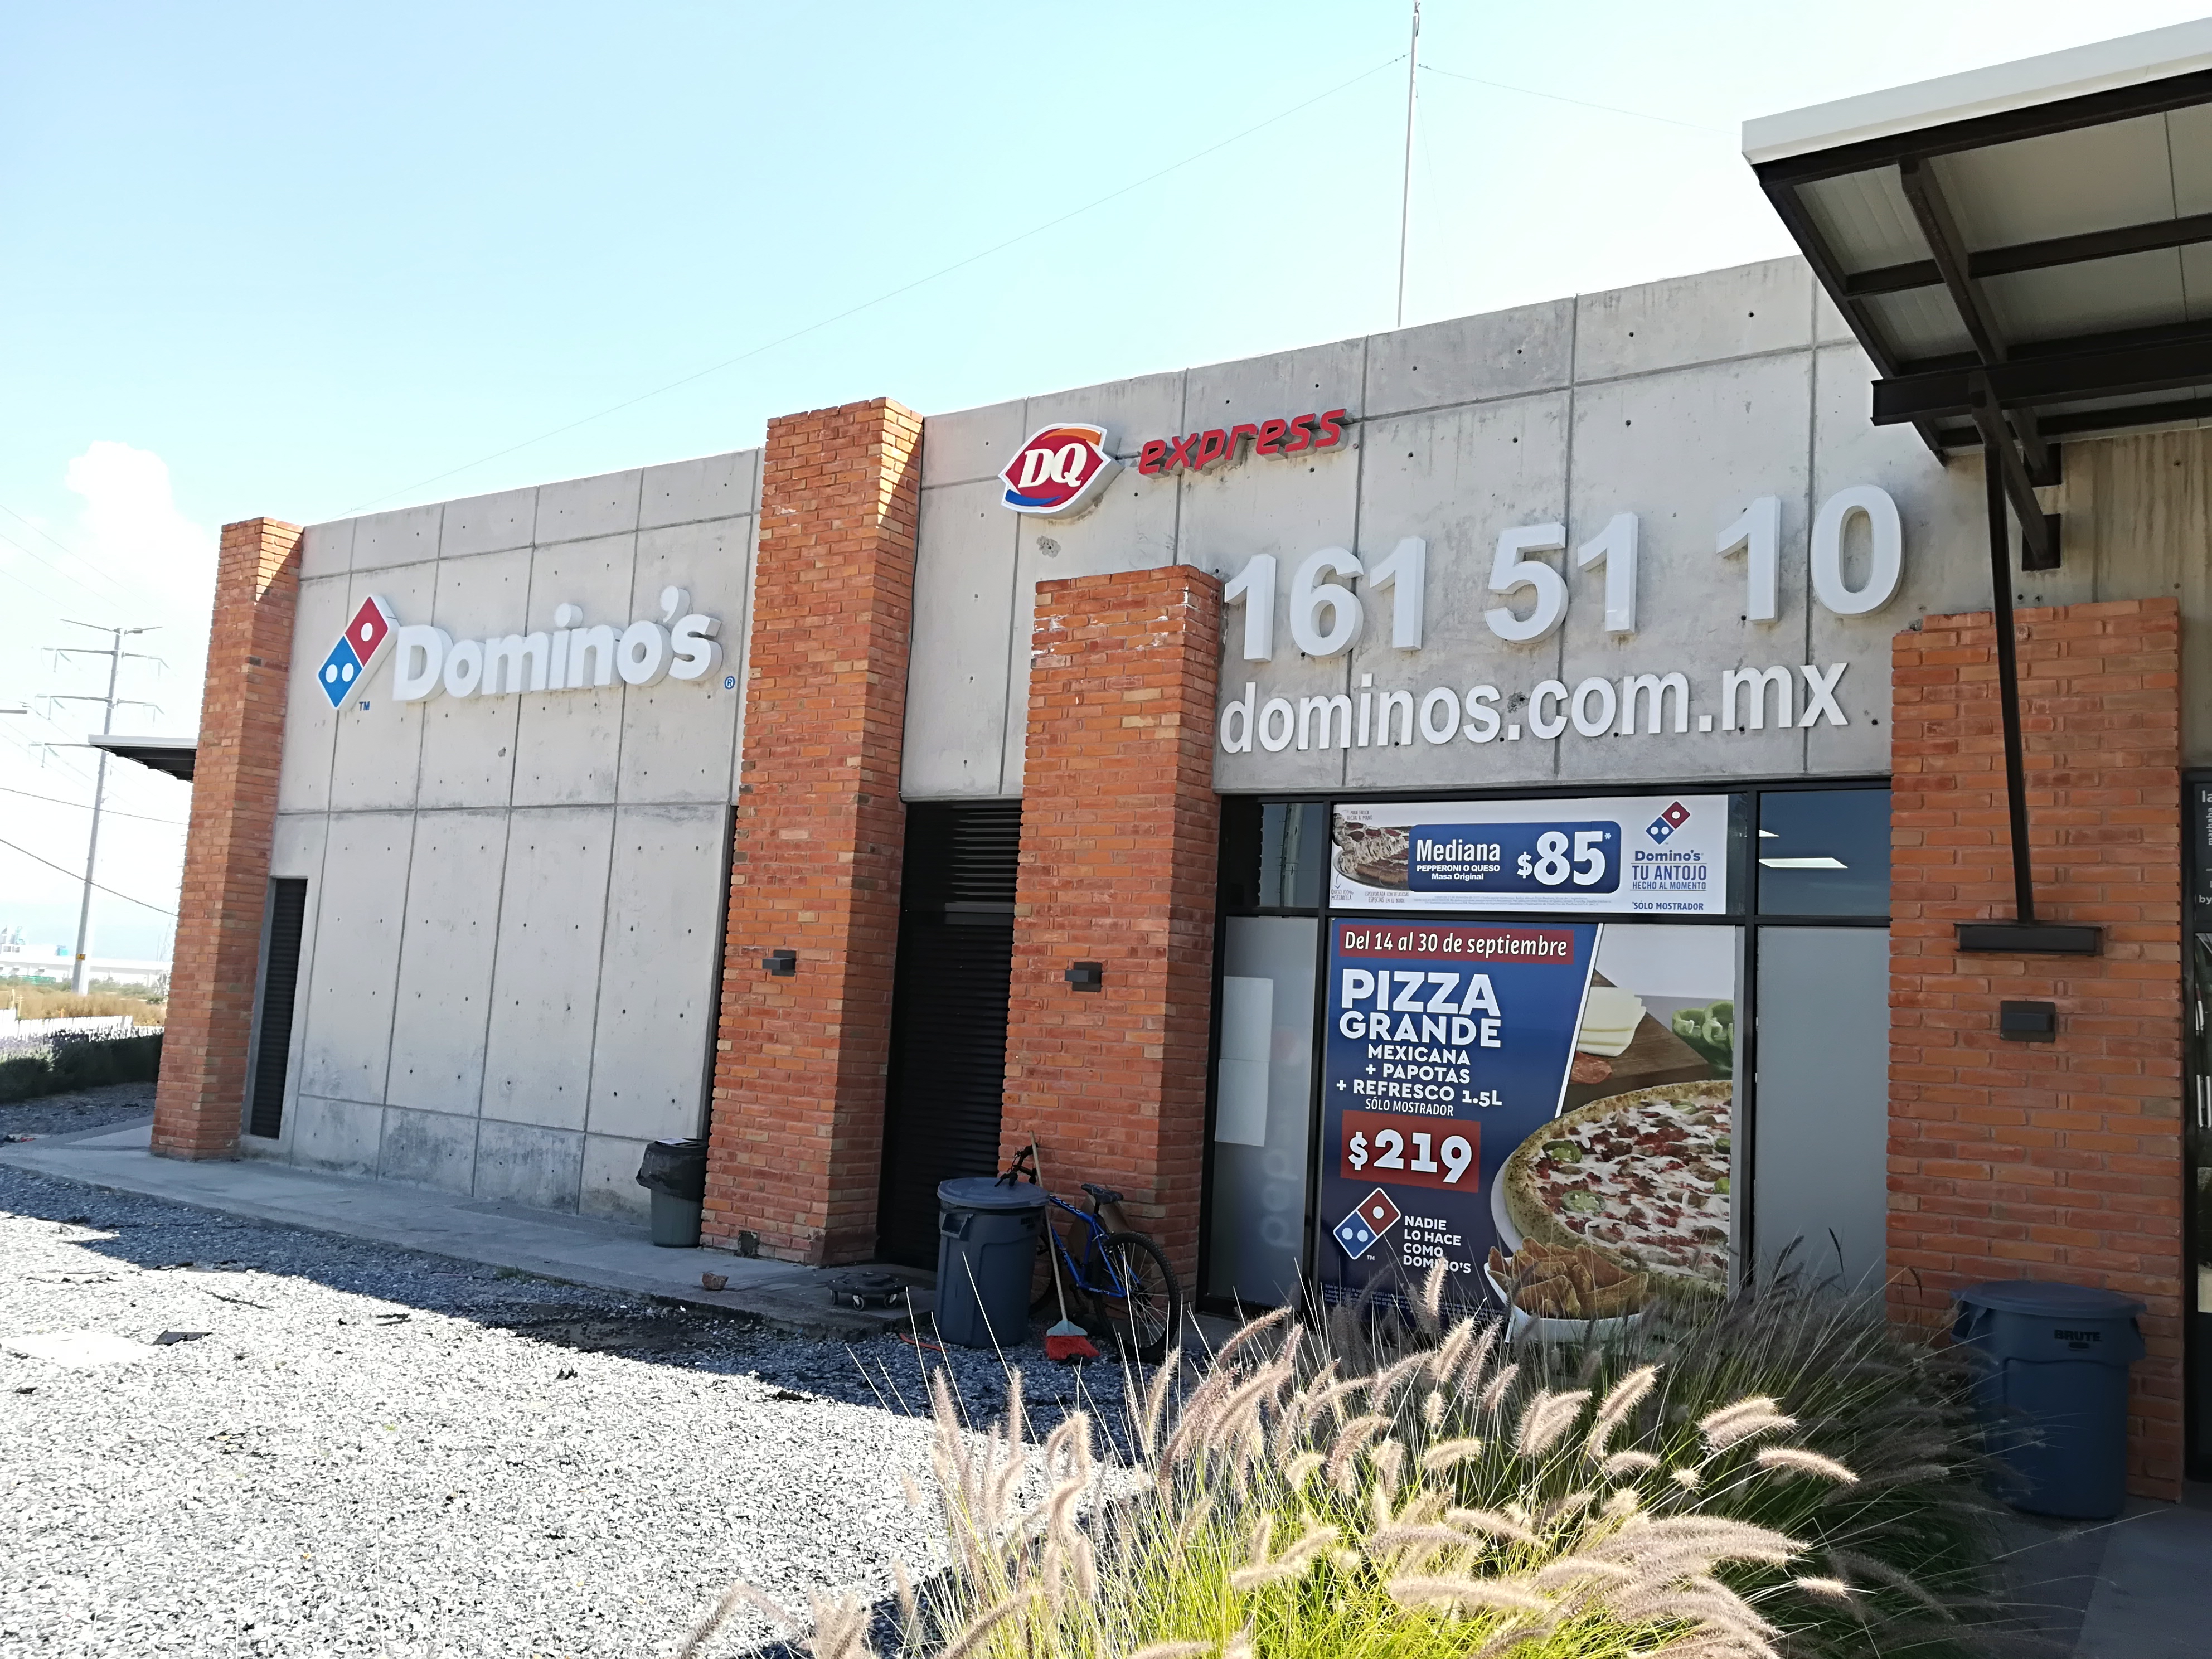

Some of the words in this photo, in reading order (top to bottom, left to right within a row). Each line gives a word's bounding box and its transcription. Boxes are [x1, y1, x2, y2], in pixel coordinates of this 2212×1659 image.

[1139, 408, 1351, 479] express
[1018, 443, 1087, 488] DQ
[1225, 536, 1426, 662] 161
[1485, 511, 1639, 644] 51
[1716, 484, 1904, 624] 10
[393, 585, 722, 702] Domino's
[1220, 662, 1848, 754] dominos.com.mx
[1417, 838, 1501, 862] Mediana
[1634, 849, 1701, 862] Domino's
[1453, 872, 1484, 881] Original
[1632, 865, 1649, 881] TU
[1653, 865, 1707, 881] ANTOJO
[1632, 881, 1657, 890] HECHO
[1670, 882, 1706, 890] MOMENTO
[1656, 902, 1704, 910] MOSTRADOR
[1345, 930, 1370, 950] Del
[1374, 933, 1393, 951] 14
[1398, 933, 1413, 952] al
[1418, 933, 1438, 952] 30
[1442, 933, 1462, 953] de
[1467, 934, 1567, 958] septiembre
[1341, 968, 1501, 1017] PIZZA
[1339, 1010, 1501, 1047] GRANDE
[1367, 1043, 1471, 1065] MEXICANA
[1382, 1064, 1471, 1084] PAPOTAS
[1353, 1079, 1455, 1102] REFRESCO
[1462, 1090, 1502, 1108] 1.5L
[1365, 1097, 1390, 1110] SÓLO
[1393, 1100, 1454, 1117] MOSTRADOR
[1348, 1128, 1472, 1183] $219
[1404, 1215, 1447, 1231] NADIE
[1404, 1229, 1421, 1241] LO
[1424, 1231, 1462, 1246] HACE
[1403, 1243, 1444, 1258] COMO
[2054, 1329, 2102, 1342] BRUTE
